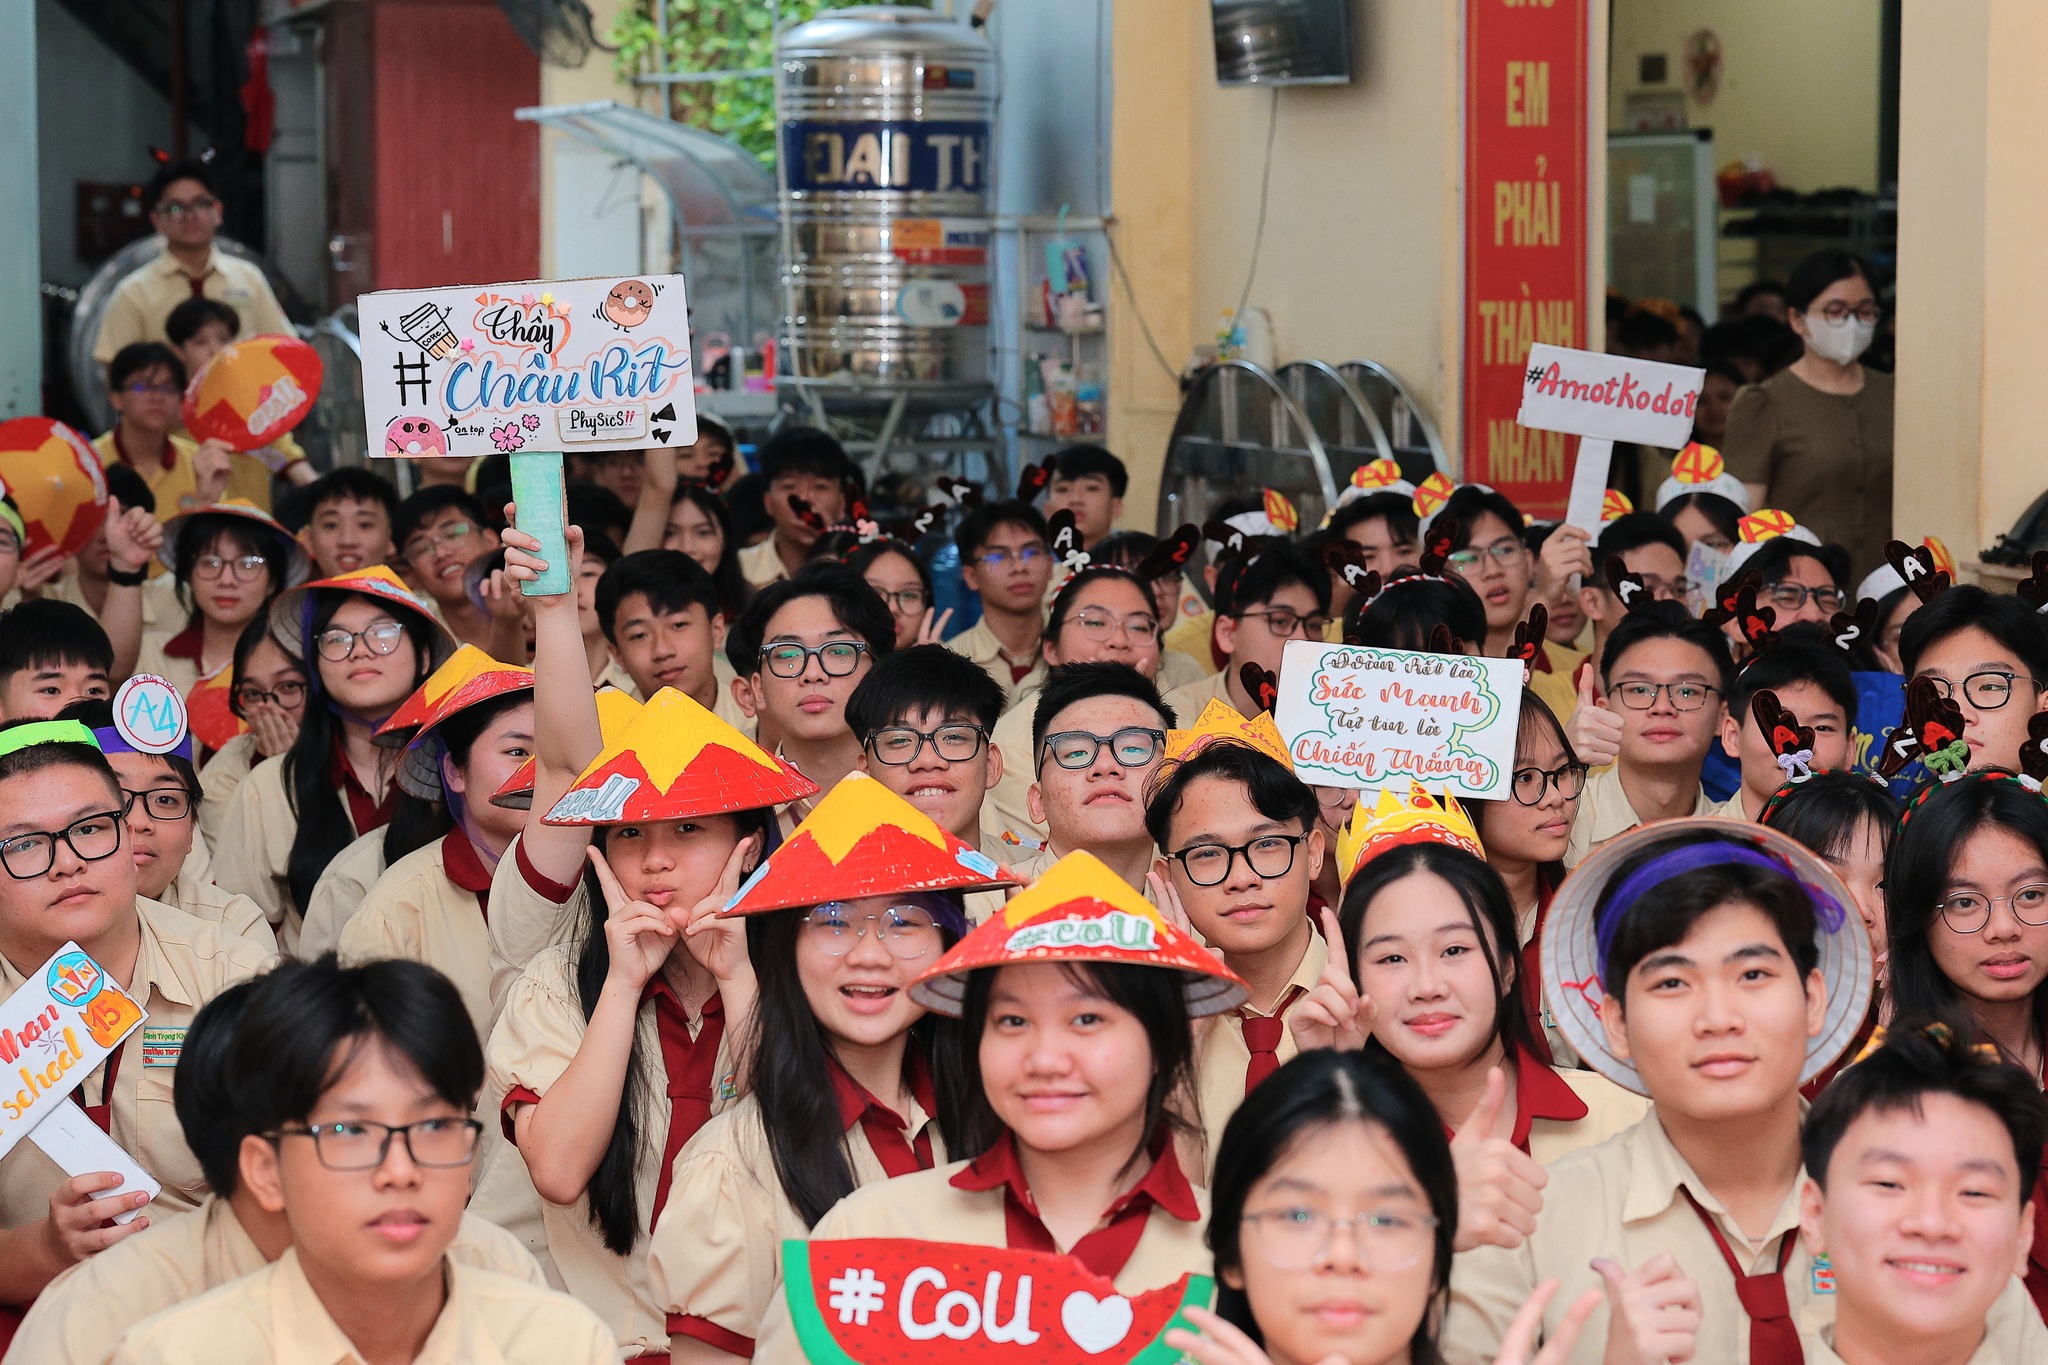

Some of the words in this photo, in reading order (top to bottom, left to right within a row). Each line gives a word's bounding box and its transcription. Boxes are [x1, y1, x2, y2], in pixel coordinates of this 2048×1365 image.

[1506, 60, 1549, 127] EM
[1494, 154, 1560, 246] PHẢI
[482, 305, 553, 354] Thầy
[1479, 282, 1574, 366] THÀNH
[1054, 526, 1073, 548] A
[1904, 556, 1927, 581] A
[1836, 625, 1860, 650] 2
[129, 691, 177, 738] A4
[1316, 674, 1366, 700] Sức
[1380, 682, 1482, 714] Mạnh
[1417, 717, 1441, 736] là
[1773, 725, 1799, 753] A
[1296, 739, 1376, 776] Chiến
[1383, 745, 1489, 786] Thắng
[2, 1026, 83, 1120] school
